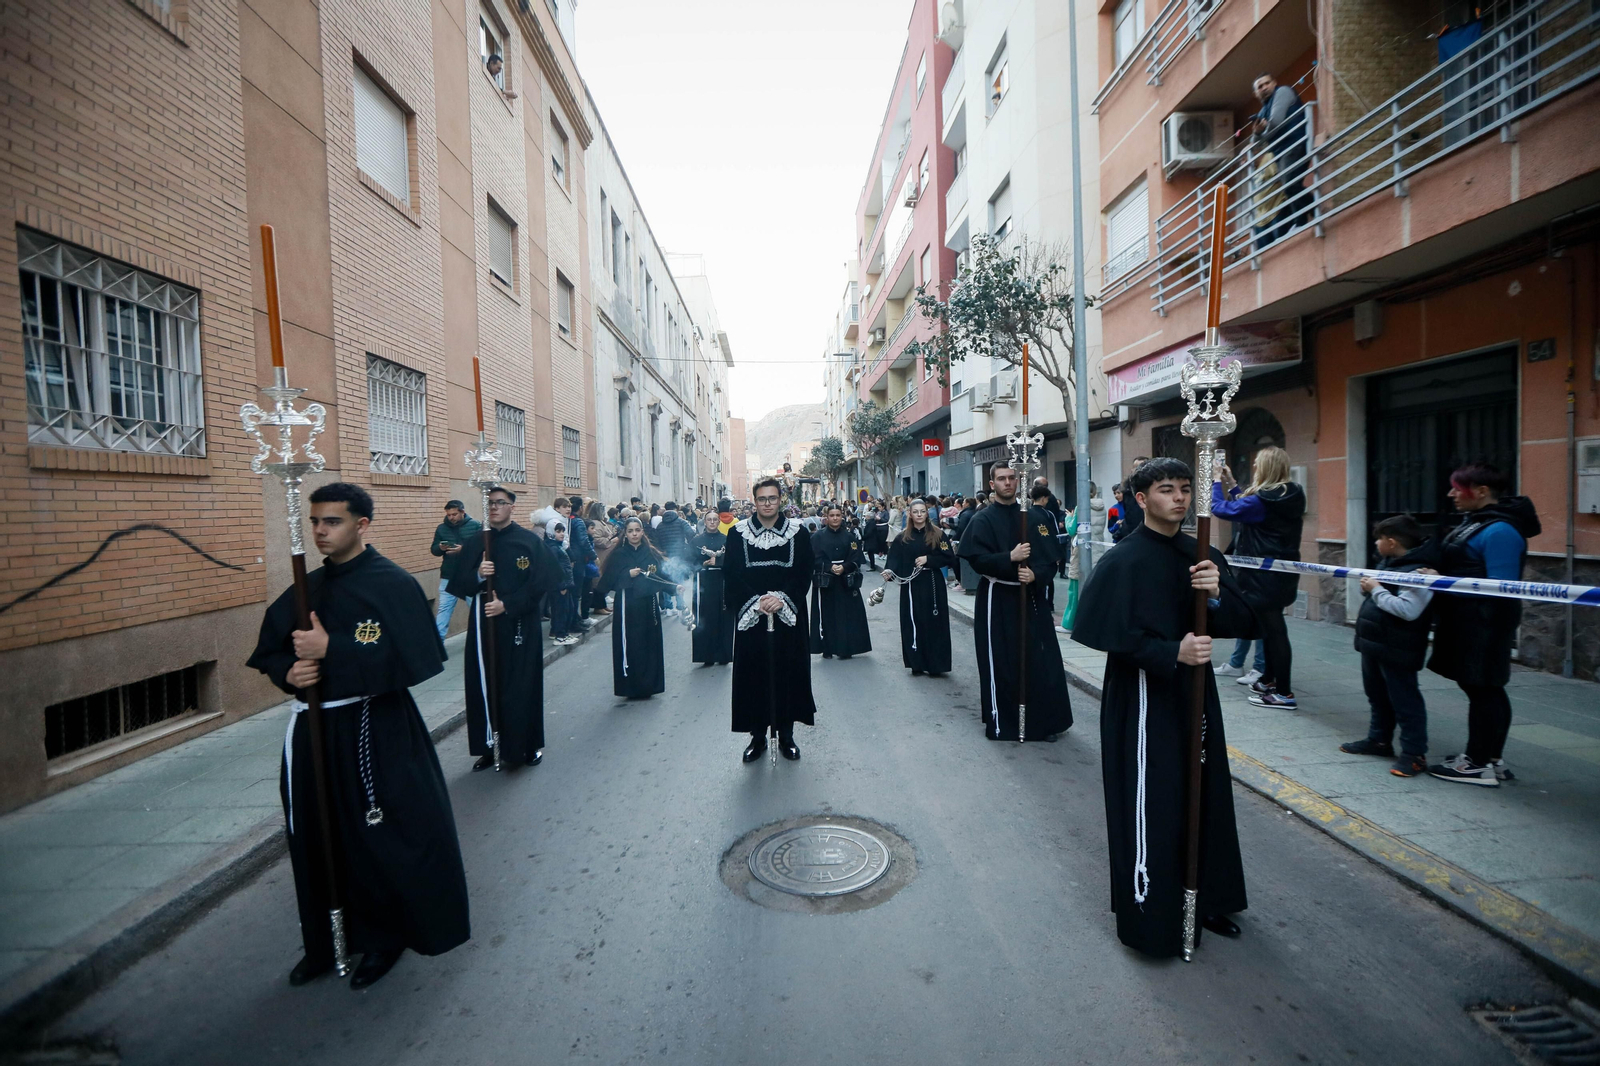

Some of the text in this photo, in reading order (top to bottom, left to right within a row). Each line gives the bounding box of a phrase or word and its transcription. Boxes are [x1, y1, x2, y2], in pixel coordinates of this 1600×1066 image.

[1530, 340, 1550, 360] 54
[1137, 355, 1175, 379] Mi familia
[1160, 374, 1171, 384] para
[1499, 580, 1569, 599] POLICIA LOCAL
